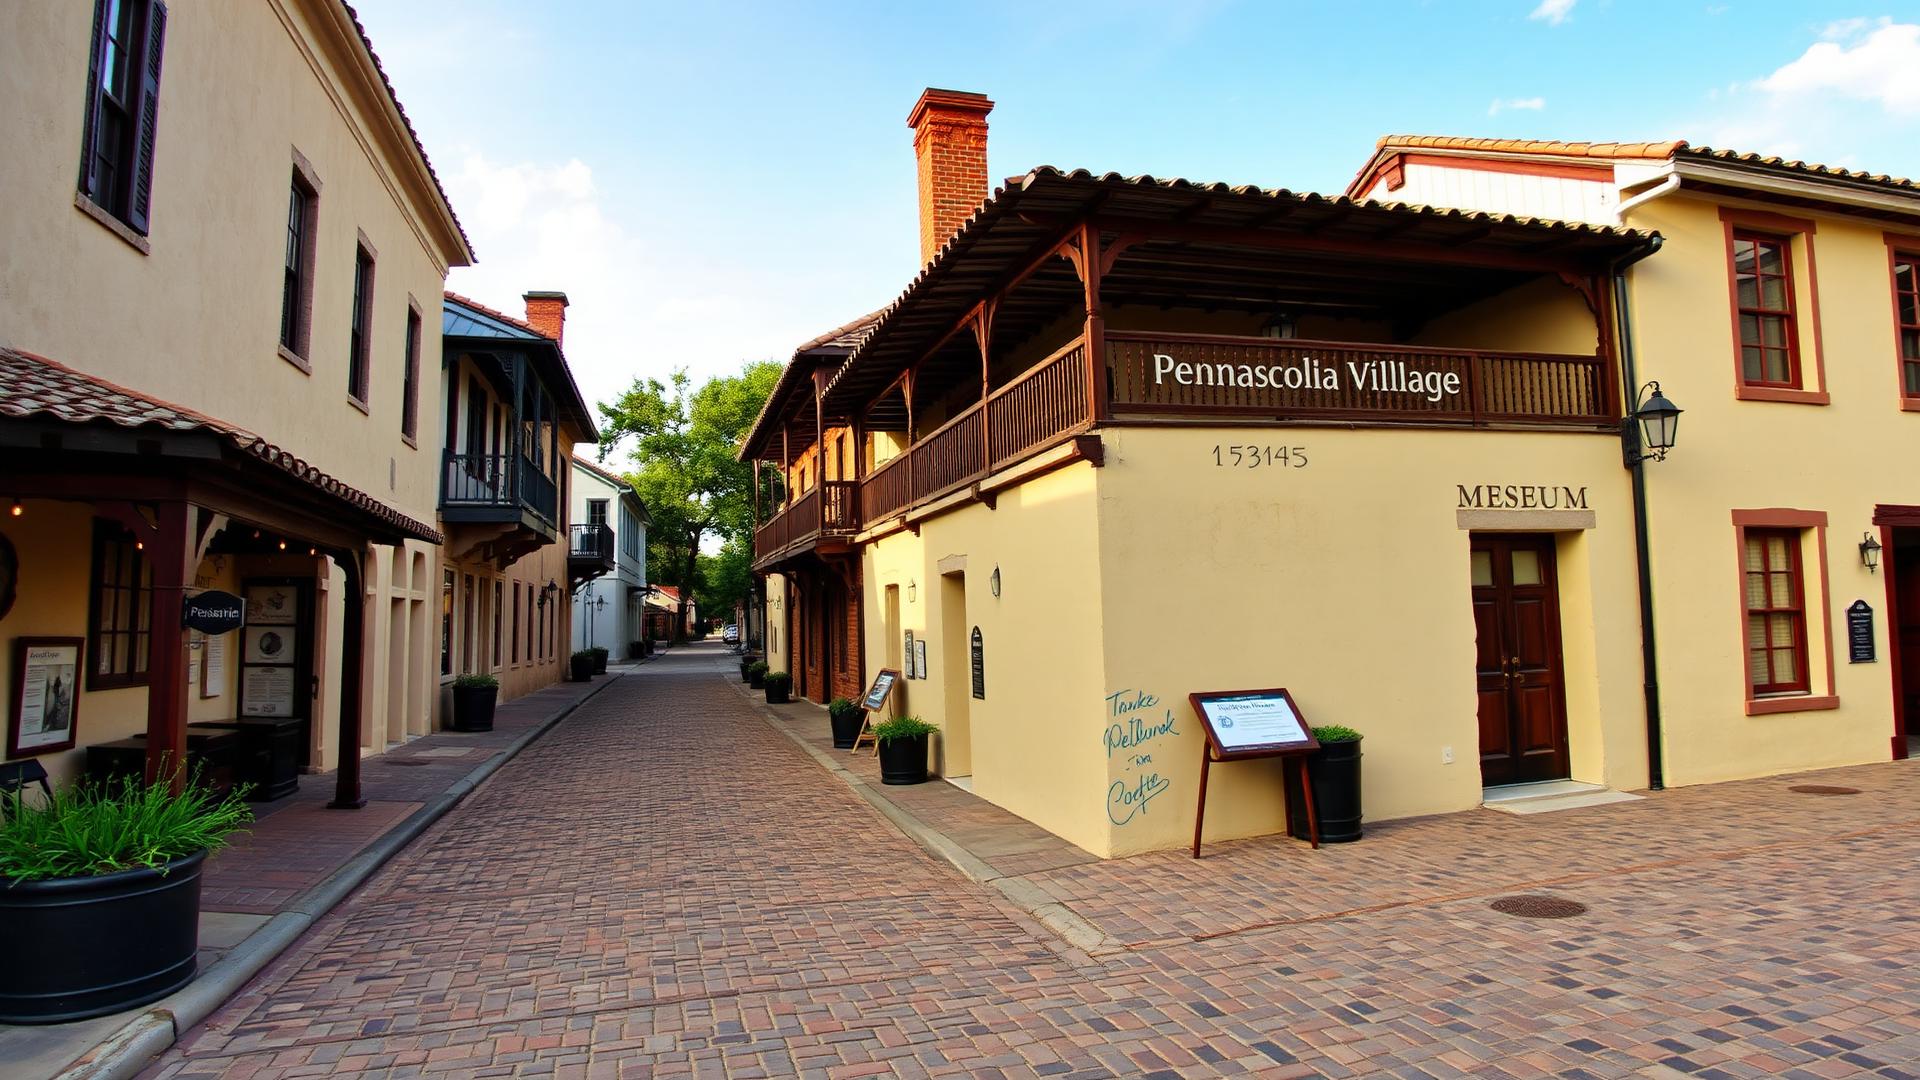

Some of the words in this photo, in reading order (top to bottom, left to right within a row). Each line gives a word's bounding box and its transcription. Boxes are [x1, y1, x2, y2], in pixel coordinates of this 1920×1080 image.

[1153, 353, 1340, 391] Pennascolia
[1213, 445, 1308, 469] 153145
[1457, 485, 1588, 509] MESEUM
